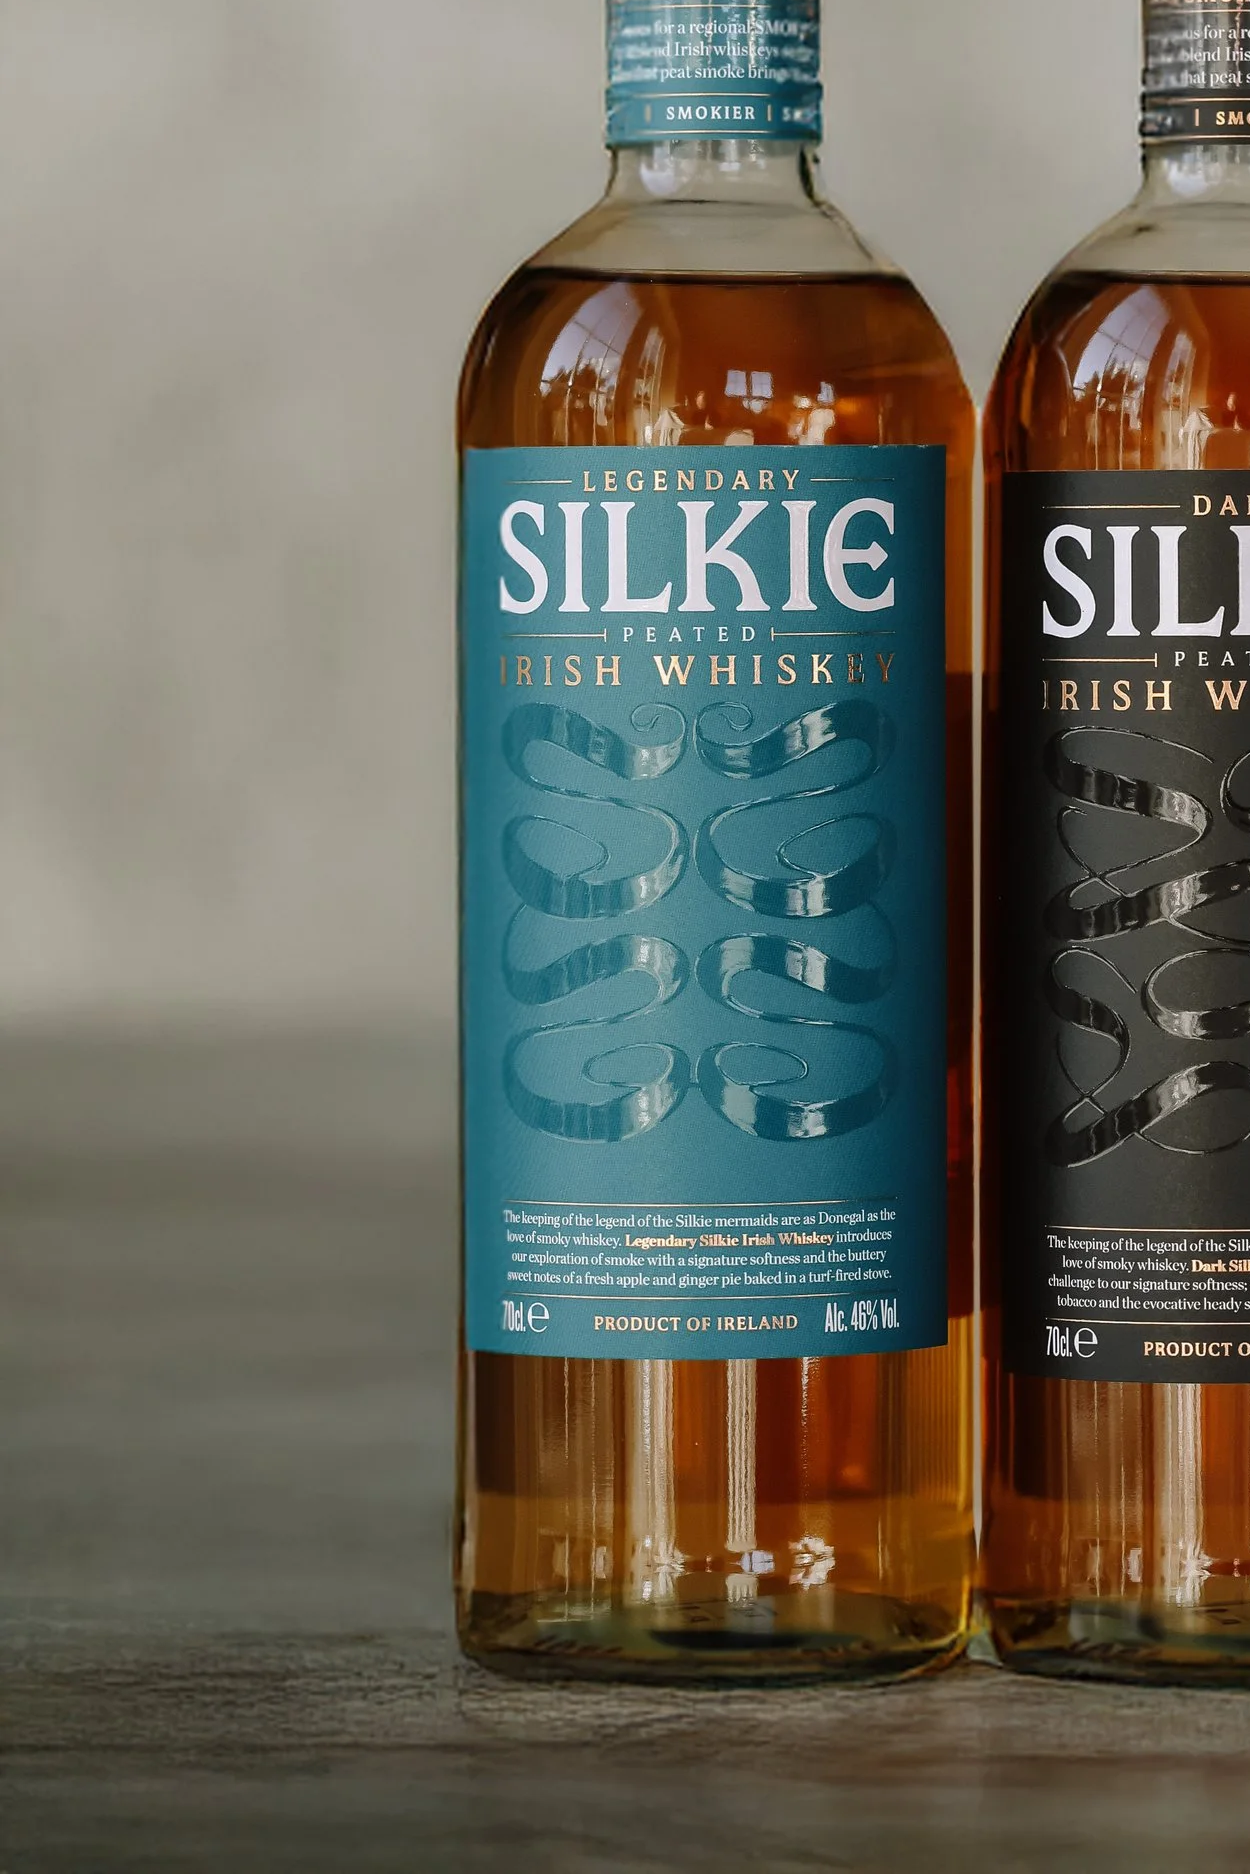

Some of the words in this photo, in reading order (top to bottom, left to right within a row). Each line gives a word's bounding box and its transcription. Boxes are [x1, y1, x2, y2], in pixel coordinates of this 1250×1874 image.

[690, 20, 750, 36] regional
[674, 42, 710, 57] Irish
[660, 65, 690, 82] peat
[695, 64, 744, 79] smoke
[1209, 71, 1242, 86] peat
[666, 106, 756, 121] SMOKIER
[583, 469, 801, 493] LEGENDARY
[500, 497, 895, 615] SILKIE
[622, 626, 757, 643] PEATED
[500, 655, 622, 687] IRISH
[653, 652, 896, 686] WHISKEY
[1042, 679, 1173, 711] IRISH
[507, 1230, 525, 1243] love
[526, 1232, 537, 1243] of
[537, 1234, 571, 1248] smoky
[573, 1234, 621, 1249] whiskey.
[625, 1234, 699, 1249] Legendary
[699, 1234, 739, 1247] Silkie
[742, 1233, 776, 1246] Irish
[778, 1231, 834, 1246] Whiskey
[836, 1229, 892, 1243] introduces
[1047, 1234, 1066, 1249] The
[1068, 1236, 1110, 1253] keeping
[1111, 1238, 1124, 1251] of
[1125, 1238, 1144, 1251] the
[1146, 1239, 1187, 1254] legend
[1190, 1239, 1203, 1252] of
[1203, 1239, 1226, 1252] the
[512, 1252, 527, 1263] our
[529, 1251, 589, 1267] exploration
[591, 1253, 604, 1266] of
[604, 1254, 645, 1267] smoke
[647, 1254, 675, 1267] with
[678, 1256, 685, 1267] a
[688, 1253, 748, 1269] signature
[750, 1252, 801, 1266] softness
[803, 1250, 825, 1264] and
[828, 1250, 846, 1263] the
[848, 1249, 887, 1263] buttery
[1062, 1255, 1083, 1269] love
[1084, 1257, 1097, 1269] of
[1097, 1258, 1135, 1273] smoky
[1137, 1258, 1190, 1274] whiskey.
[1191, 1259, 1227, 1273] Dark
[507, 1270, 532, 1282] sweet
[534, 1273, 561, 1284] notes
[563, 1272, 576, 1284] of
[576, 1276, 582, 1284] a
[584, 1272, 614, 1285] fresh
[616, 1273, 650, 1288] apple
[652, 1273, 676, 1286] and
[679, 1275, 720, 1288] ginger
[722, 1273, 741, 1288] pie
[744, 1271, 783, 1285] baked
[785, 1272, 796, 1284] in
[799, 1275, 807, 1283] a
[809, 1268, 861, 1282] turf-fired
[863, 1268, 892, 1280] stove.
[1048, 1274, 1095, 1290] challenge
[1097, 1278, 1109, 1289] to
[1111, 1280, 1131, 1290] our
[1133, 1278, 1190, 1293] signature
[1192, 1277, 1248, 1292] softness;
[1057, 1294, 1096, 1308] tobacco
[1099, 1296, 1120, 1309] and
[1122, 1296, 1141, 1310] the
[1143, 1298, 1201, 1310] evocative
[1203, 1297, 1242, 1313] heady
[502, 1300, 526, 1332] 70cl.
[594, 1315, 681, 1332] PRODUCT
[686, 1316, 711, 1332] OF
[717, 1315, 799, 1331] IRELAND
[824, 1302, 848, 1333] Alc.
[851, 1299, 878, 1331] 46%
[880, 1298, 900, 1328] Vol.
[1046, 1326, 1072, 1358] 70cl.
[1144, 1341, 1233, 1357] PRODUCT
